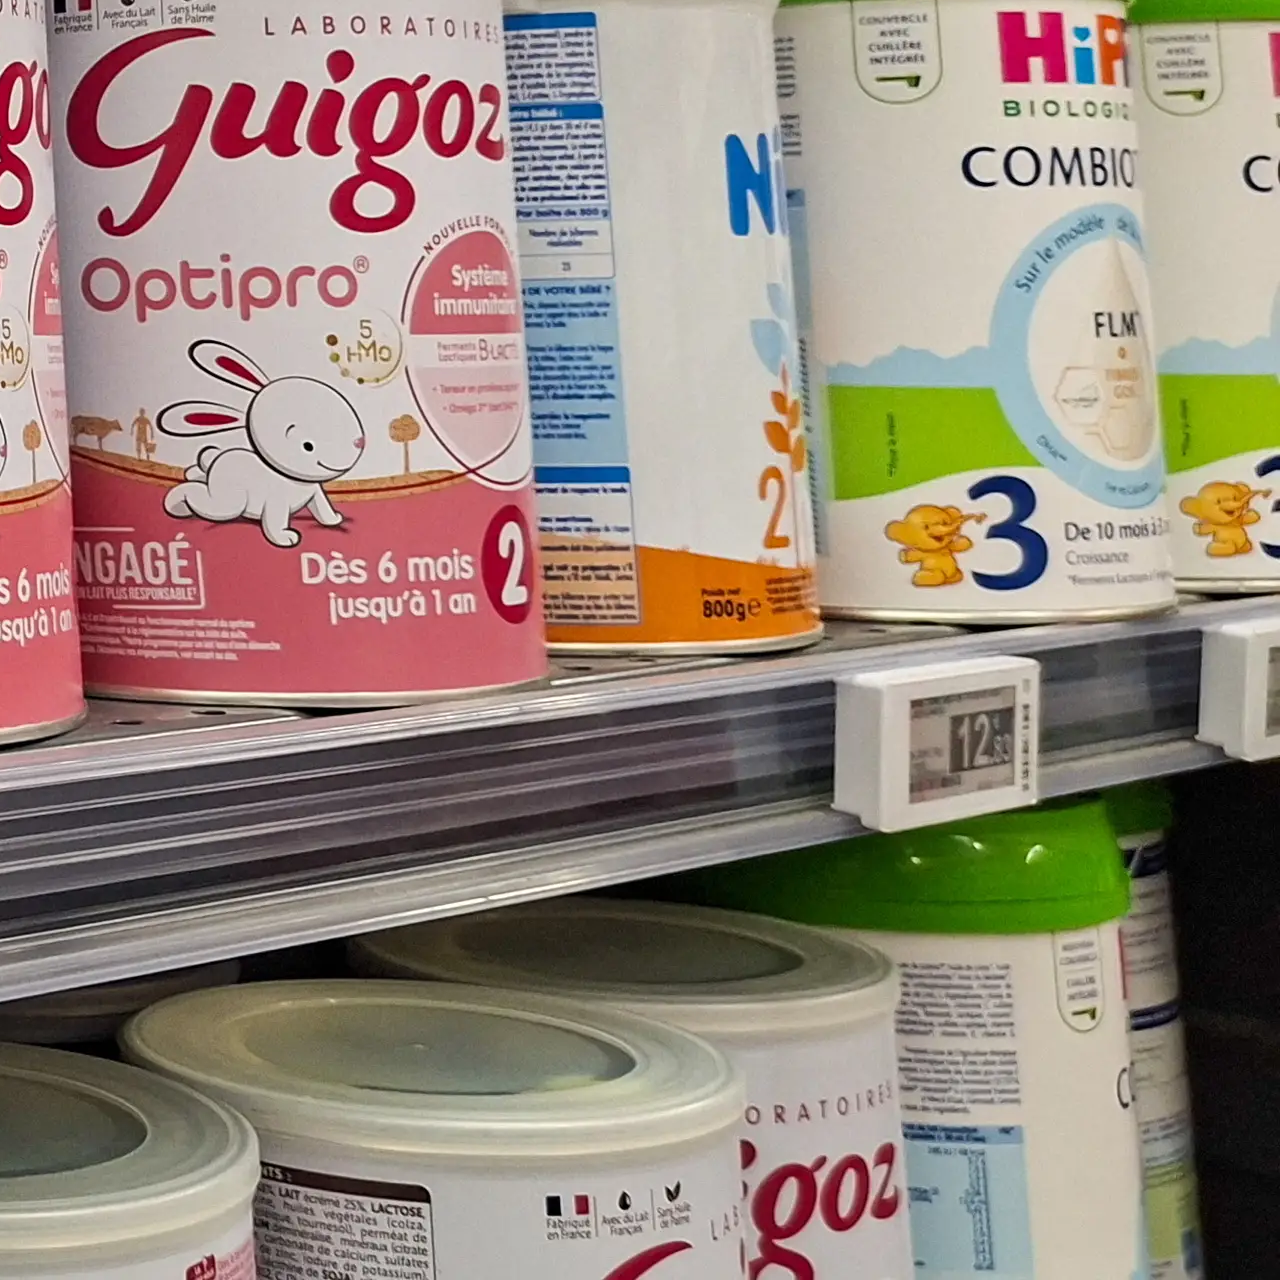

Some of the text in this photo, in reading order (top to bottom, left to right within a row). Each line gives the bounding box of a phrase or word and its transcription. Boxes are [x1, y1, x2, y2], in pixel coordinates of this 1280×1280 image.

[263, 16, 502, 43] LABORATOIRES
[997, 11, 1128, 85] HiP
[66, 28, 505, 237] Guigoz
[962, 146, 1135, 188] COMBIO
[424, 215, 481, 255] NOUVELLE
[451, 265, 509, 292] Système
[360, 319, 372, 339] 5
[758, 465, 791, 549] 2
[968, 475, 1049, 592] 3
[1064, 520, 1149, 542] De 10 mois
[301, 548, 474, 586] Dès 6 mois
[499, 521, 529, 605] 2
[1066, 550, 1130, 566] Croissance
[18, 569, 31, 601] 6
[36, 568, 69, 599] mois
[328, 590, 424, 625] jusqu'à
